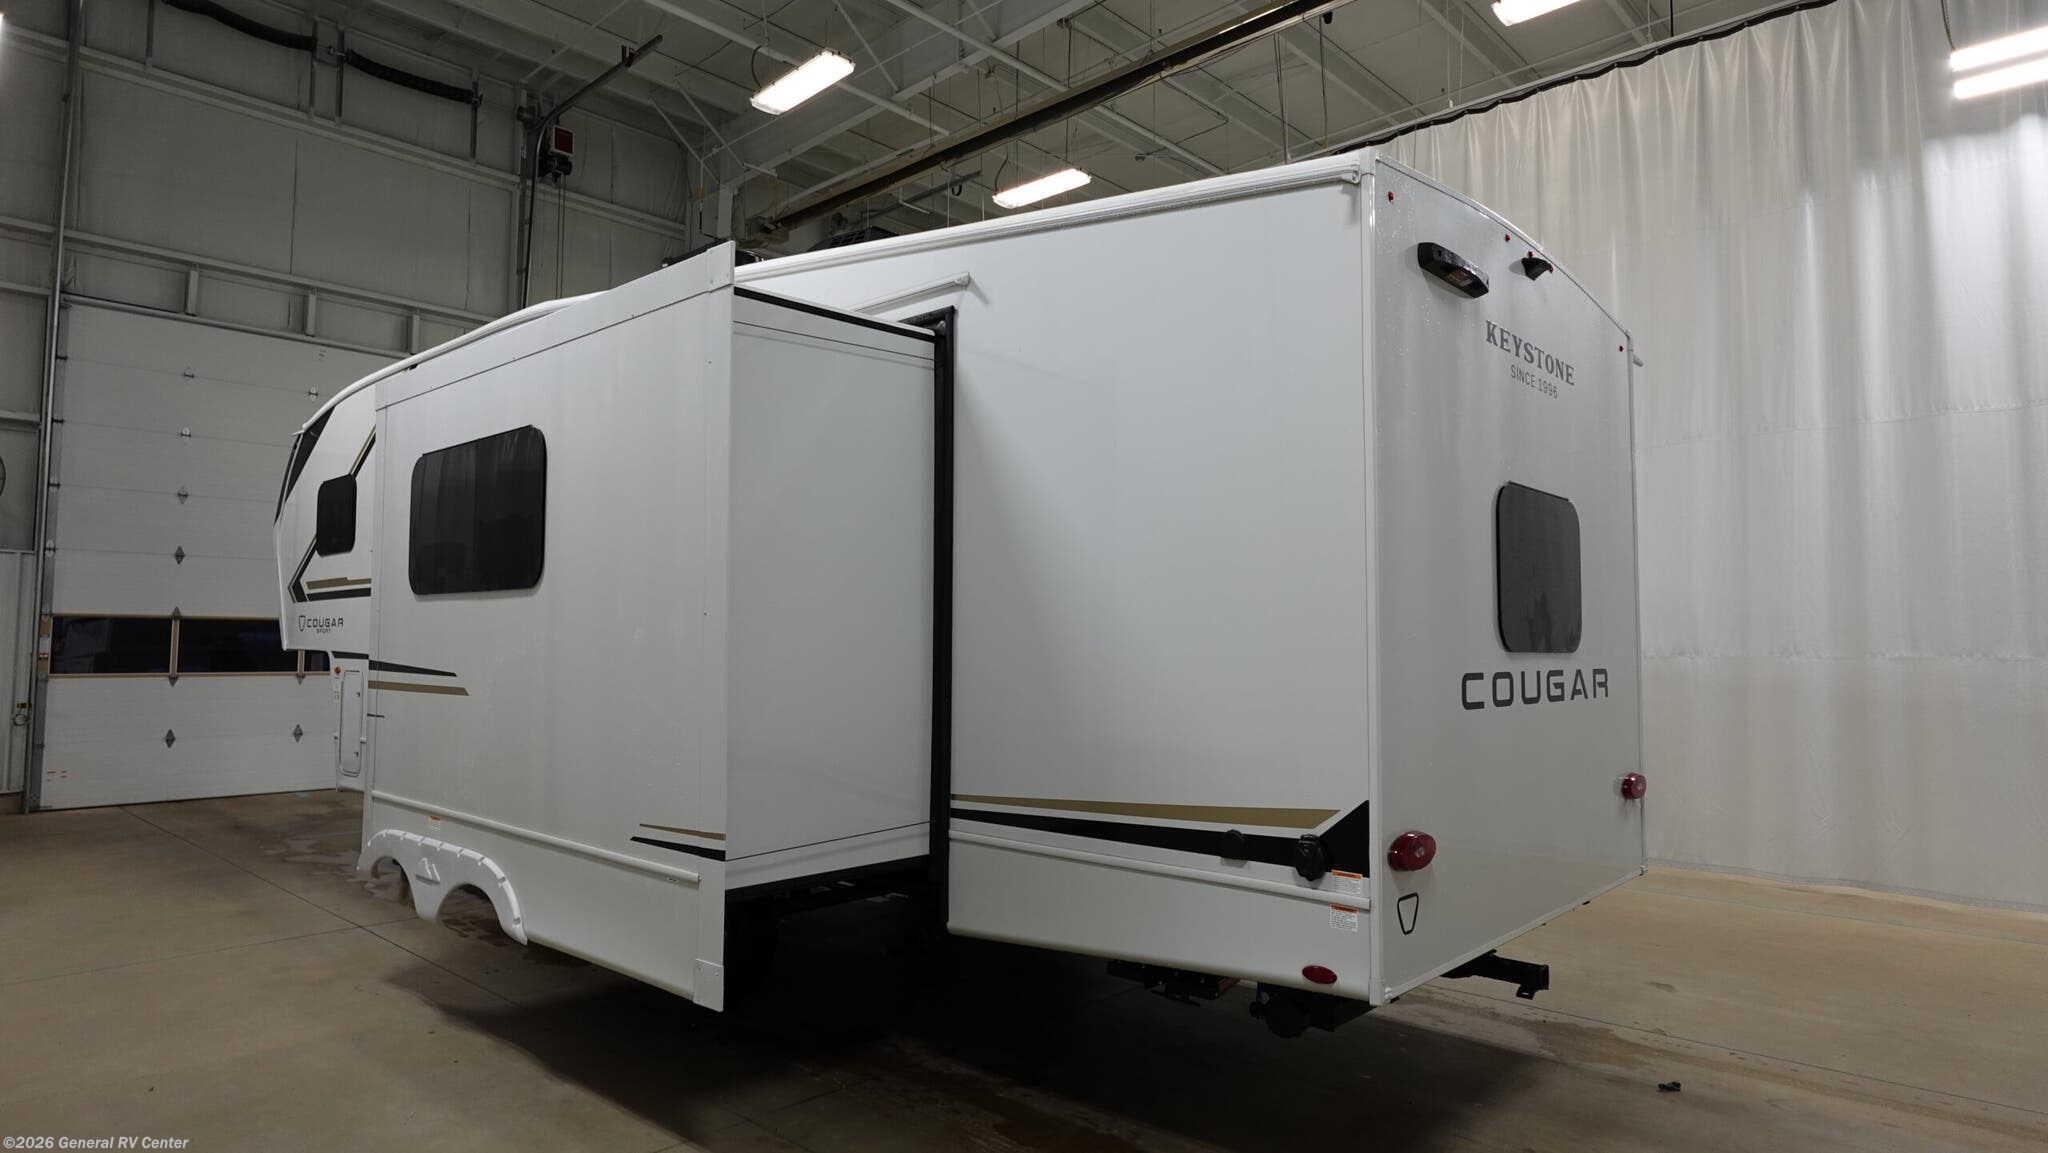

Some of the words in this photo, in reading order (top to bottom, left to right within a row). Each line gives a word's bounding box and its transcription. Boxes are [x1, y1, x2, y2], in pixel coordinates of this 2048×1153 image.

[1486, 319, 1575, 386] KEYSTONE
[1511, 364, 1535, 388] SINCE
[1538, 378, 1558, 399] 1996
[306, 617, 344, 628] COUGAR
[1461, 668, 1609, 710] COUGAR
